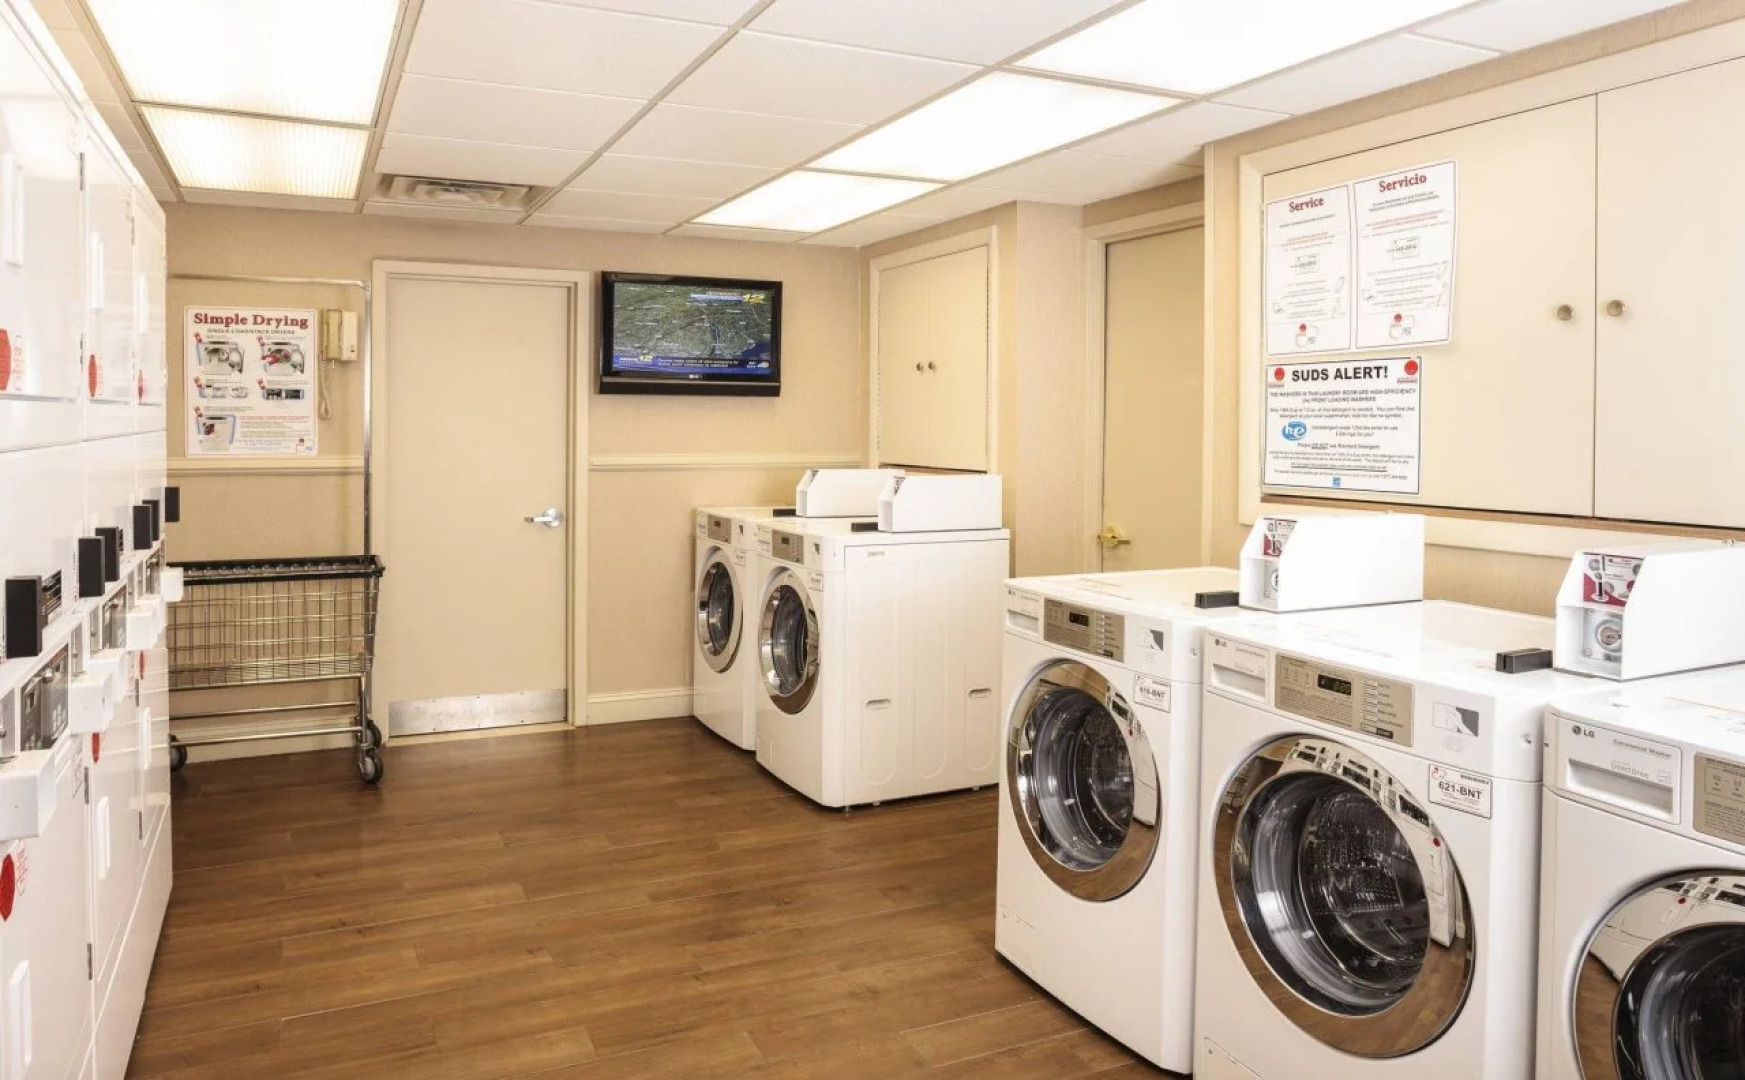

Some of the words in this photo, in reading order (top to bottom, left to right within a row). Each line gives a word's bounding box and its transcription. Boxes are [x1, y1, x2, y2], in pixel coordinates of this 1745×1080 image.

[1379, 173, 1428, 193] Servicio
[1289, 197, 1325, 213] Service
[194, 313, 248, 328] Simple
[252, 314, 308, 330] Drying
[1292, 368, 1329, 382] SUDS
[1334, 365, 1389, 380] ALERT!
[1438, 780, 1483, 800] 621-BNT
